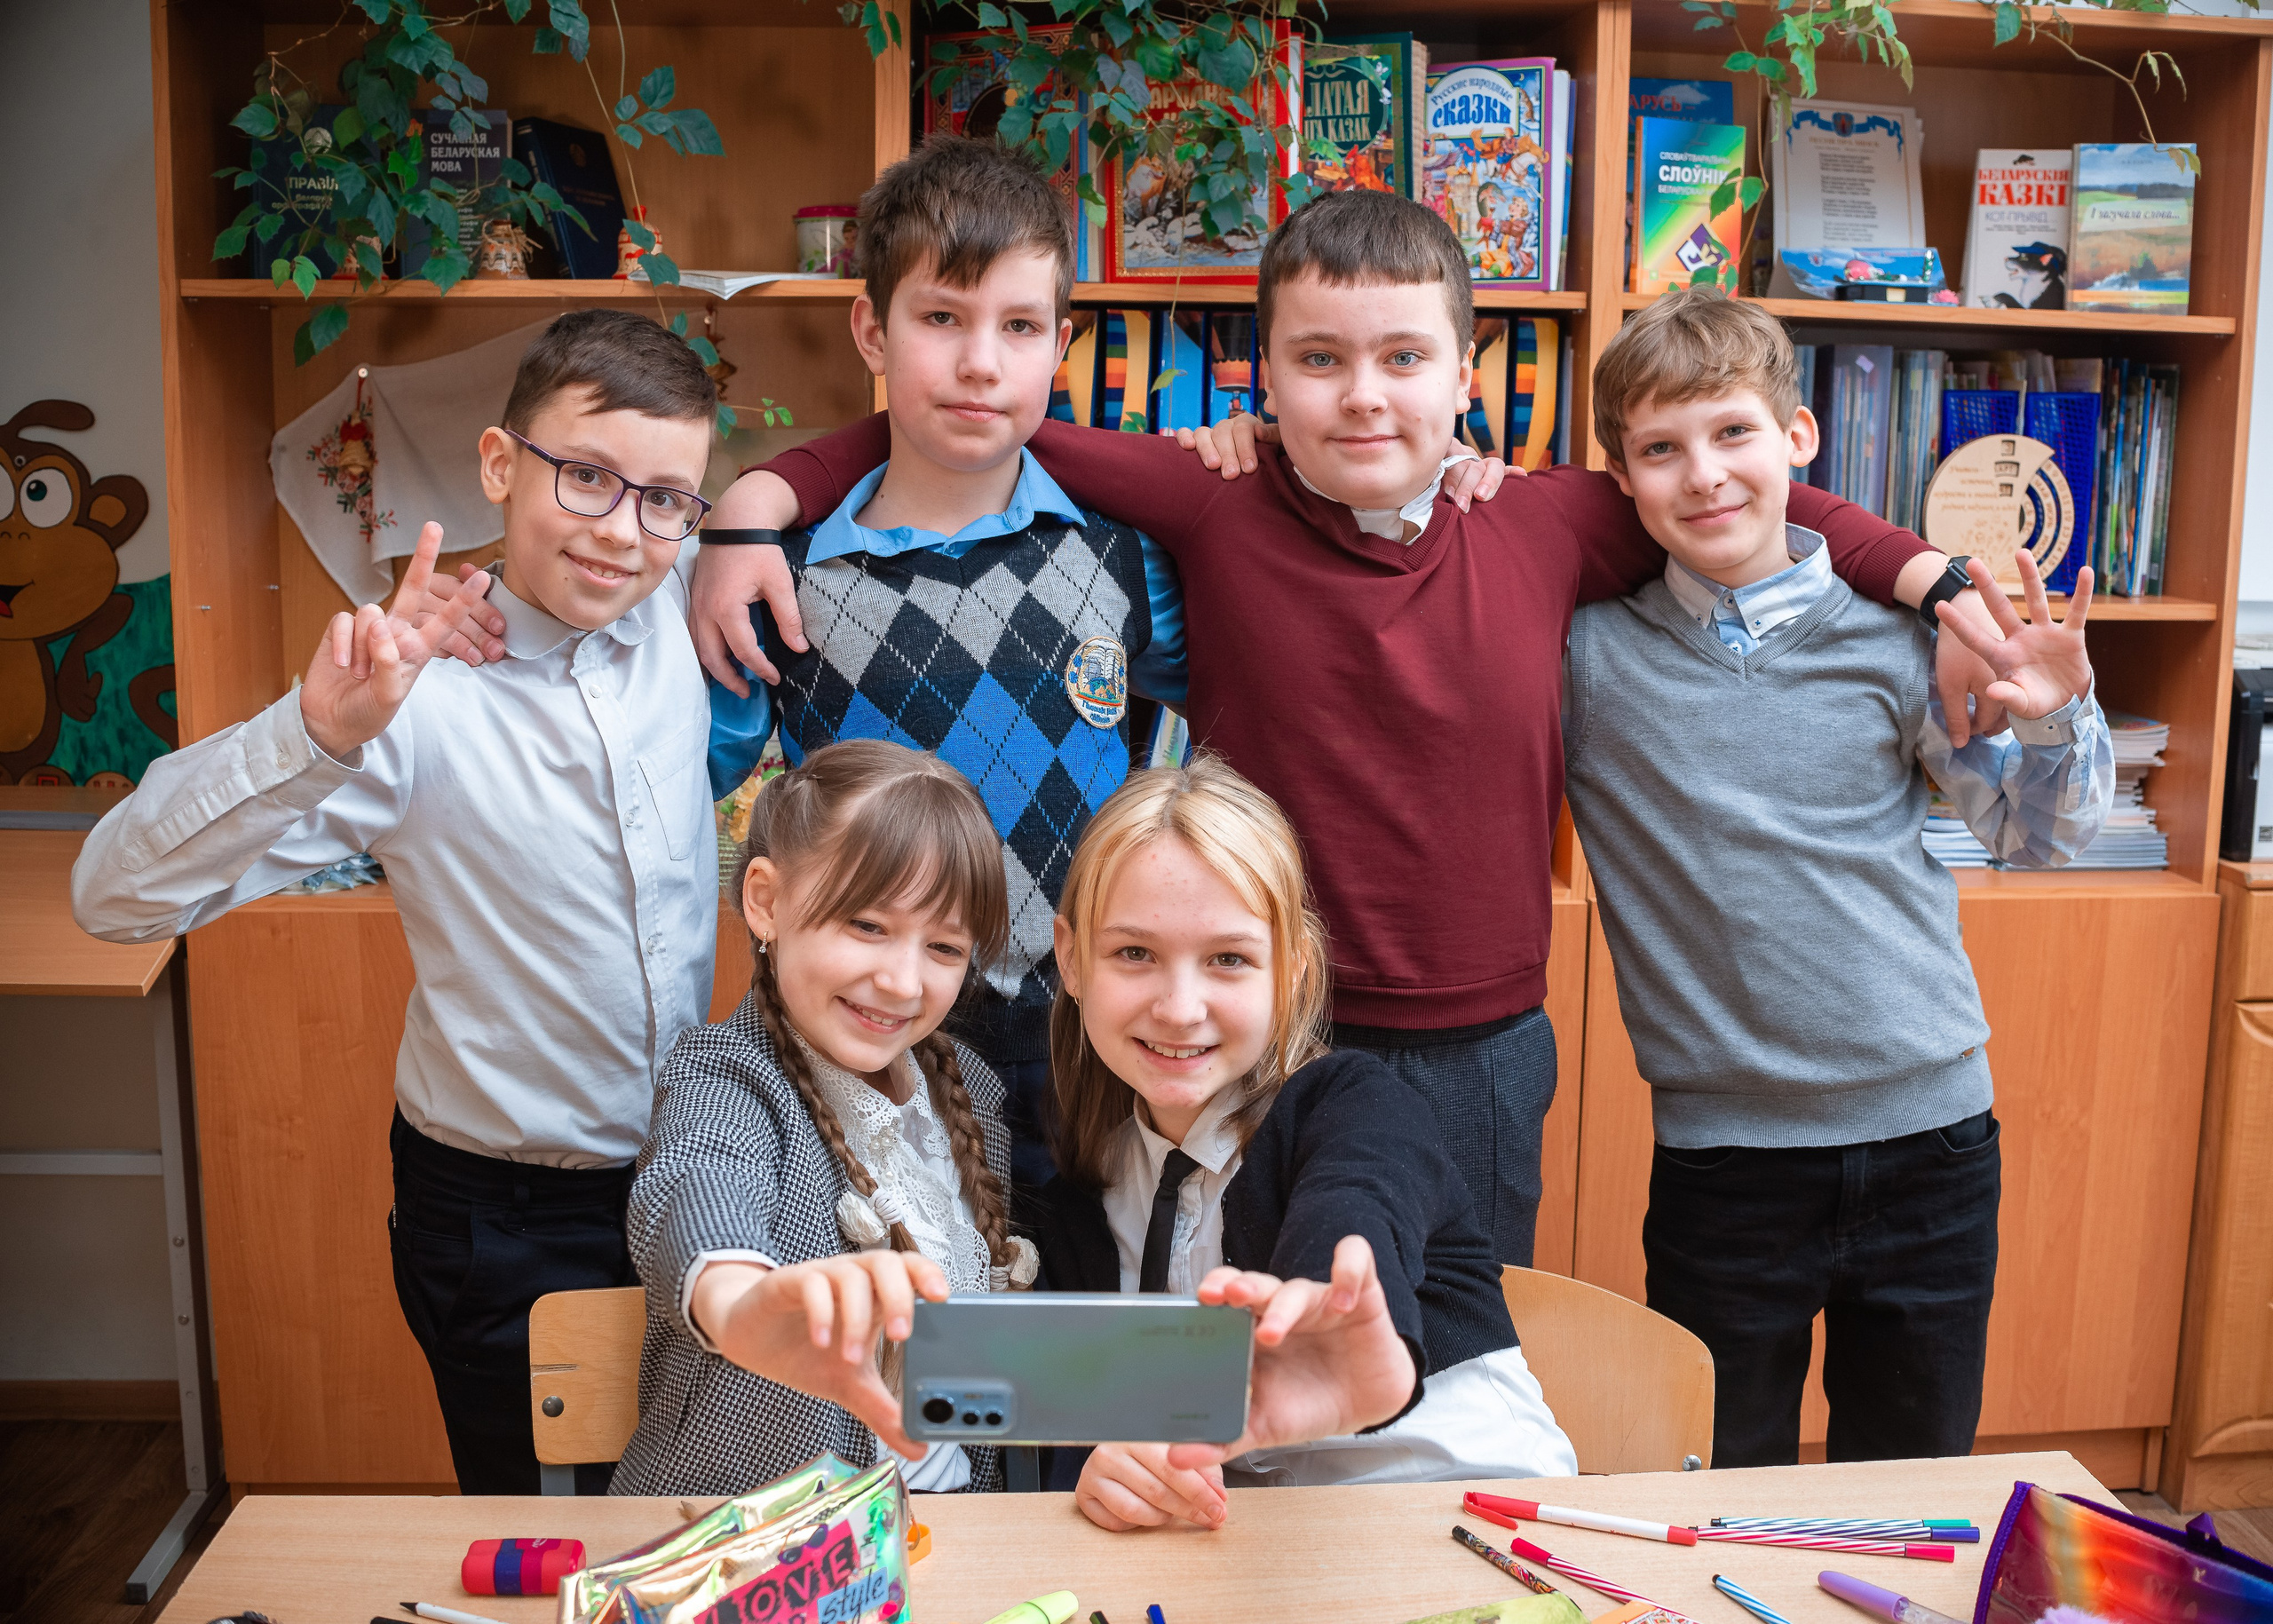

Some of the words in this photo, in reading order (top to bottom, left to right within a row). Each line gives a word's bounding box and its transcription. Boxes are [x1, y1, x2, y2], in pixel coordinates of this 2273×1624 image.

[1307, 79, 1370, 117] ЛАТАЯ
[1628, 94, 1683, 112] АРУСЬ
[1432, 93, 1512, 129] сказки
[431, 132, 487, 144] СУЧАНАЯ
[1327, 117, 1372, 142] КАЗАК
[431, 147, 501, 158] БЕЛАРУСКАЯ
[431, 161, 462, 172] МОВА
[1659, 163, 1730, 185] СЛОЎНІК
[289, 174, 339, 191] ПРАВІЛ
[1978, 183, 2067, 206] КАЗКІ
[821, 1569, 884, 1624] style
